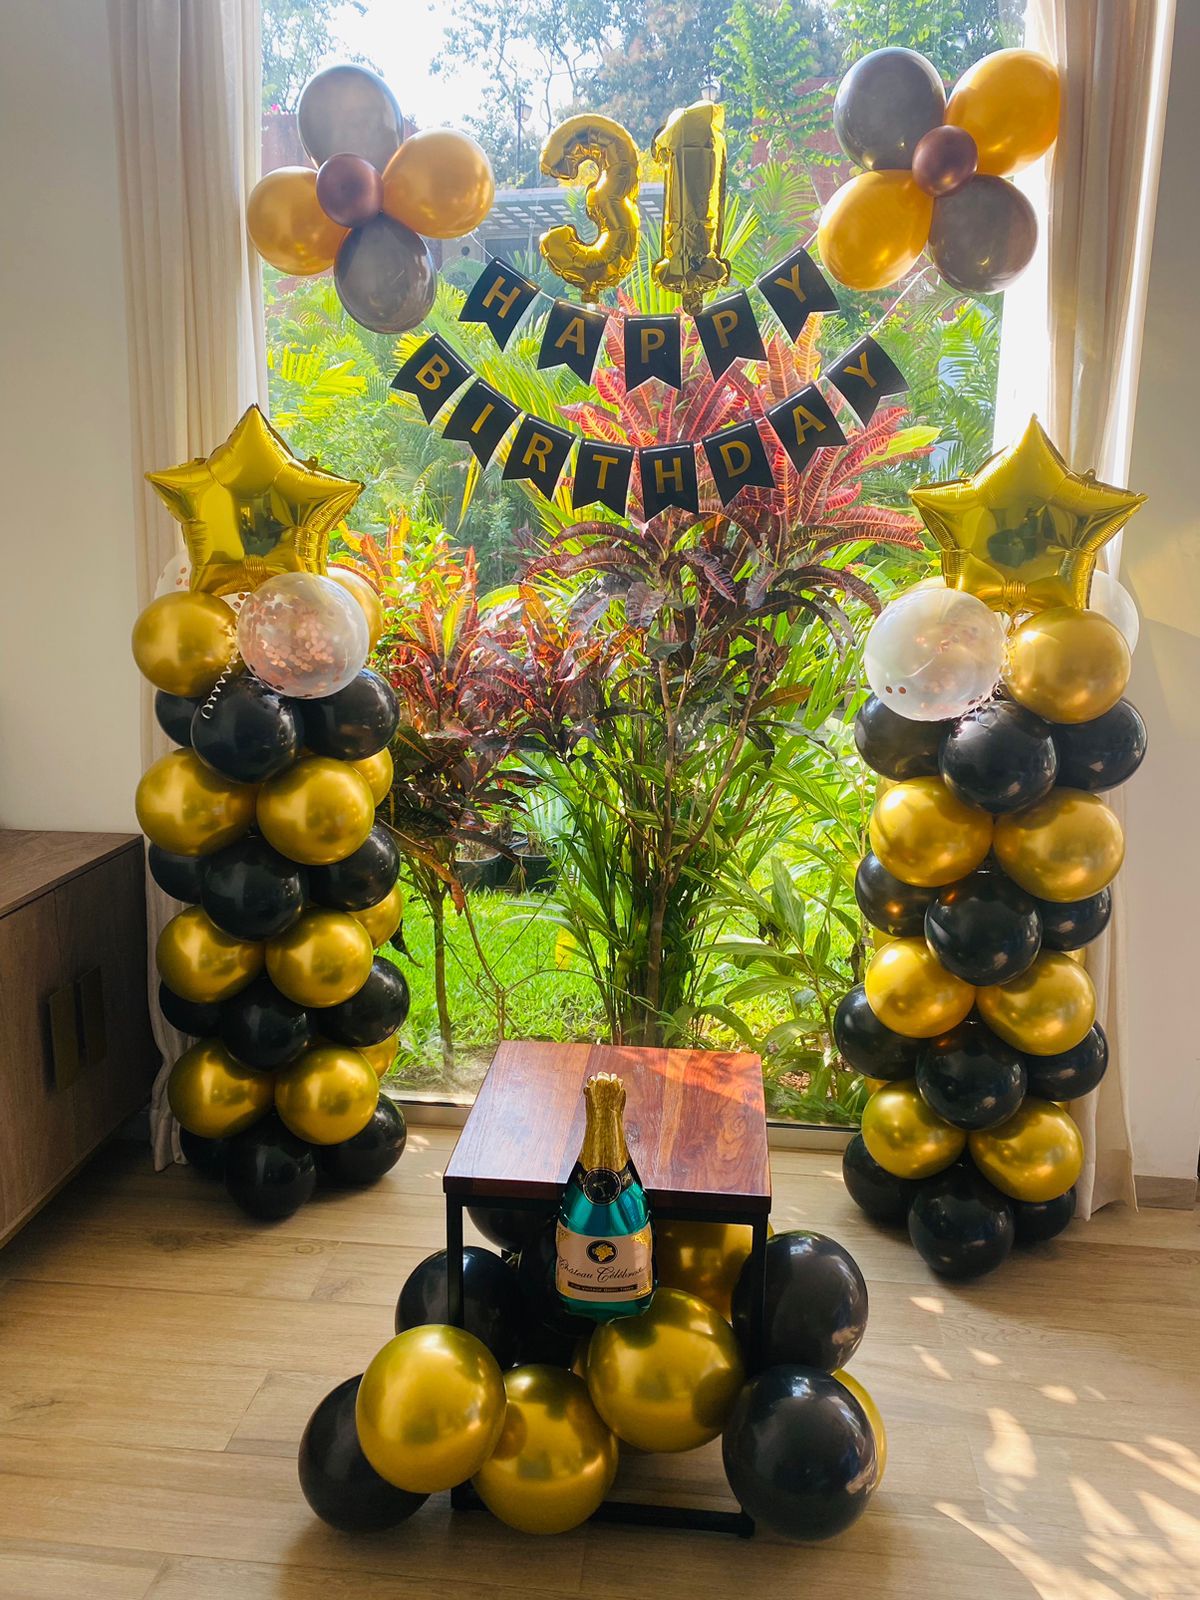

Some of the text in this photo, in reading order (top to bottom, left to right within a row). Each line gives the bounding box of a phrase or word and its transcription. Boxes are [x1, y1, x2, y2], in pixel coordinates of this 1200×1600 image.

[539, 100, 731, 295] 31
[481, 263, 808, 365] HAPPY
[415, 352, 879, 493] BIRTHDAY
